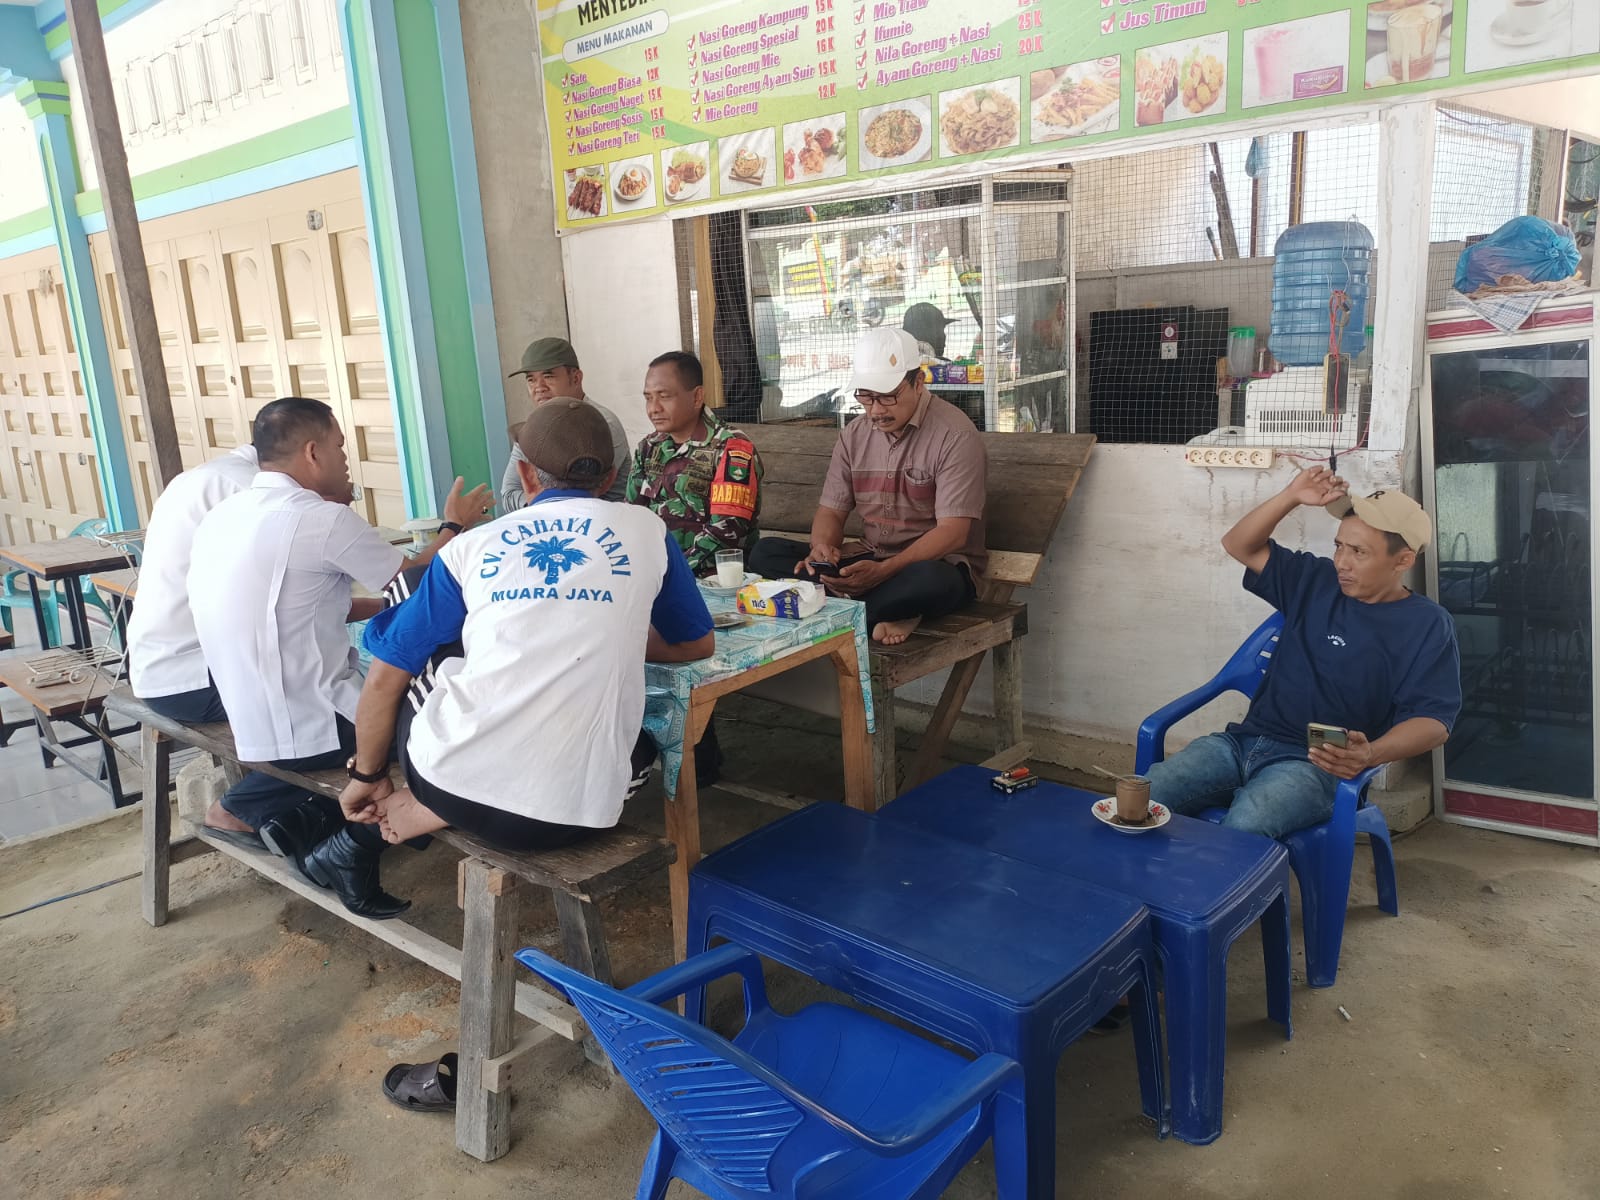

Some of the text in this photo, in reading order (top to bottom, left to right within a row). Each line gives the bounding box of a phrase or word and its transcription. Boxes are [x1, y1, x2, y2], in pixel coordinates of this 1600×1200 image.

[699, 5, 809, 46] Nasi Goreng Kampung
[873, 2, 896, 20] Mie
[1119, 0, 1207, 31] Jus Timun
[577, 20, 653, 55] MENU MAKANAN
[700, 25, 799, 65] Nasi Goreng Spesial
[875, 22, 991, 65] Nila Goreng + Nasi
[570, 72, 587, 85] Sate
[702, 53, 781, 84] Nasi Goreng Mie
[876, 43, 1002, 86] Ayam Goreng + Nasi
[572, 76, 642, 103] Nasi Goreng Biasa
[703, 64, 815, 104] Nasi Goreng Ayam Suir
[573, 93, 644, 121] Nasi Goreng Naget
[704, 101, 759, 122] Mie Goreng
[575, 111, 644, 138] Nasi Goreng Sosis
[577, 129, 640, 155] Nasi Goreng Teri
[501, 517, 593, 546] CAHAYA
[595, 527, 632, 577] TANI
[491, 587, 613, 603] MUARA JAYA
